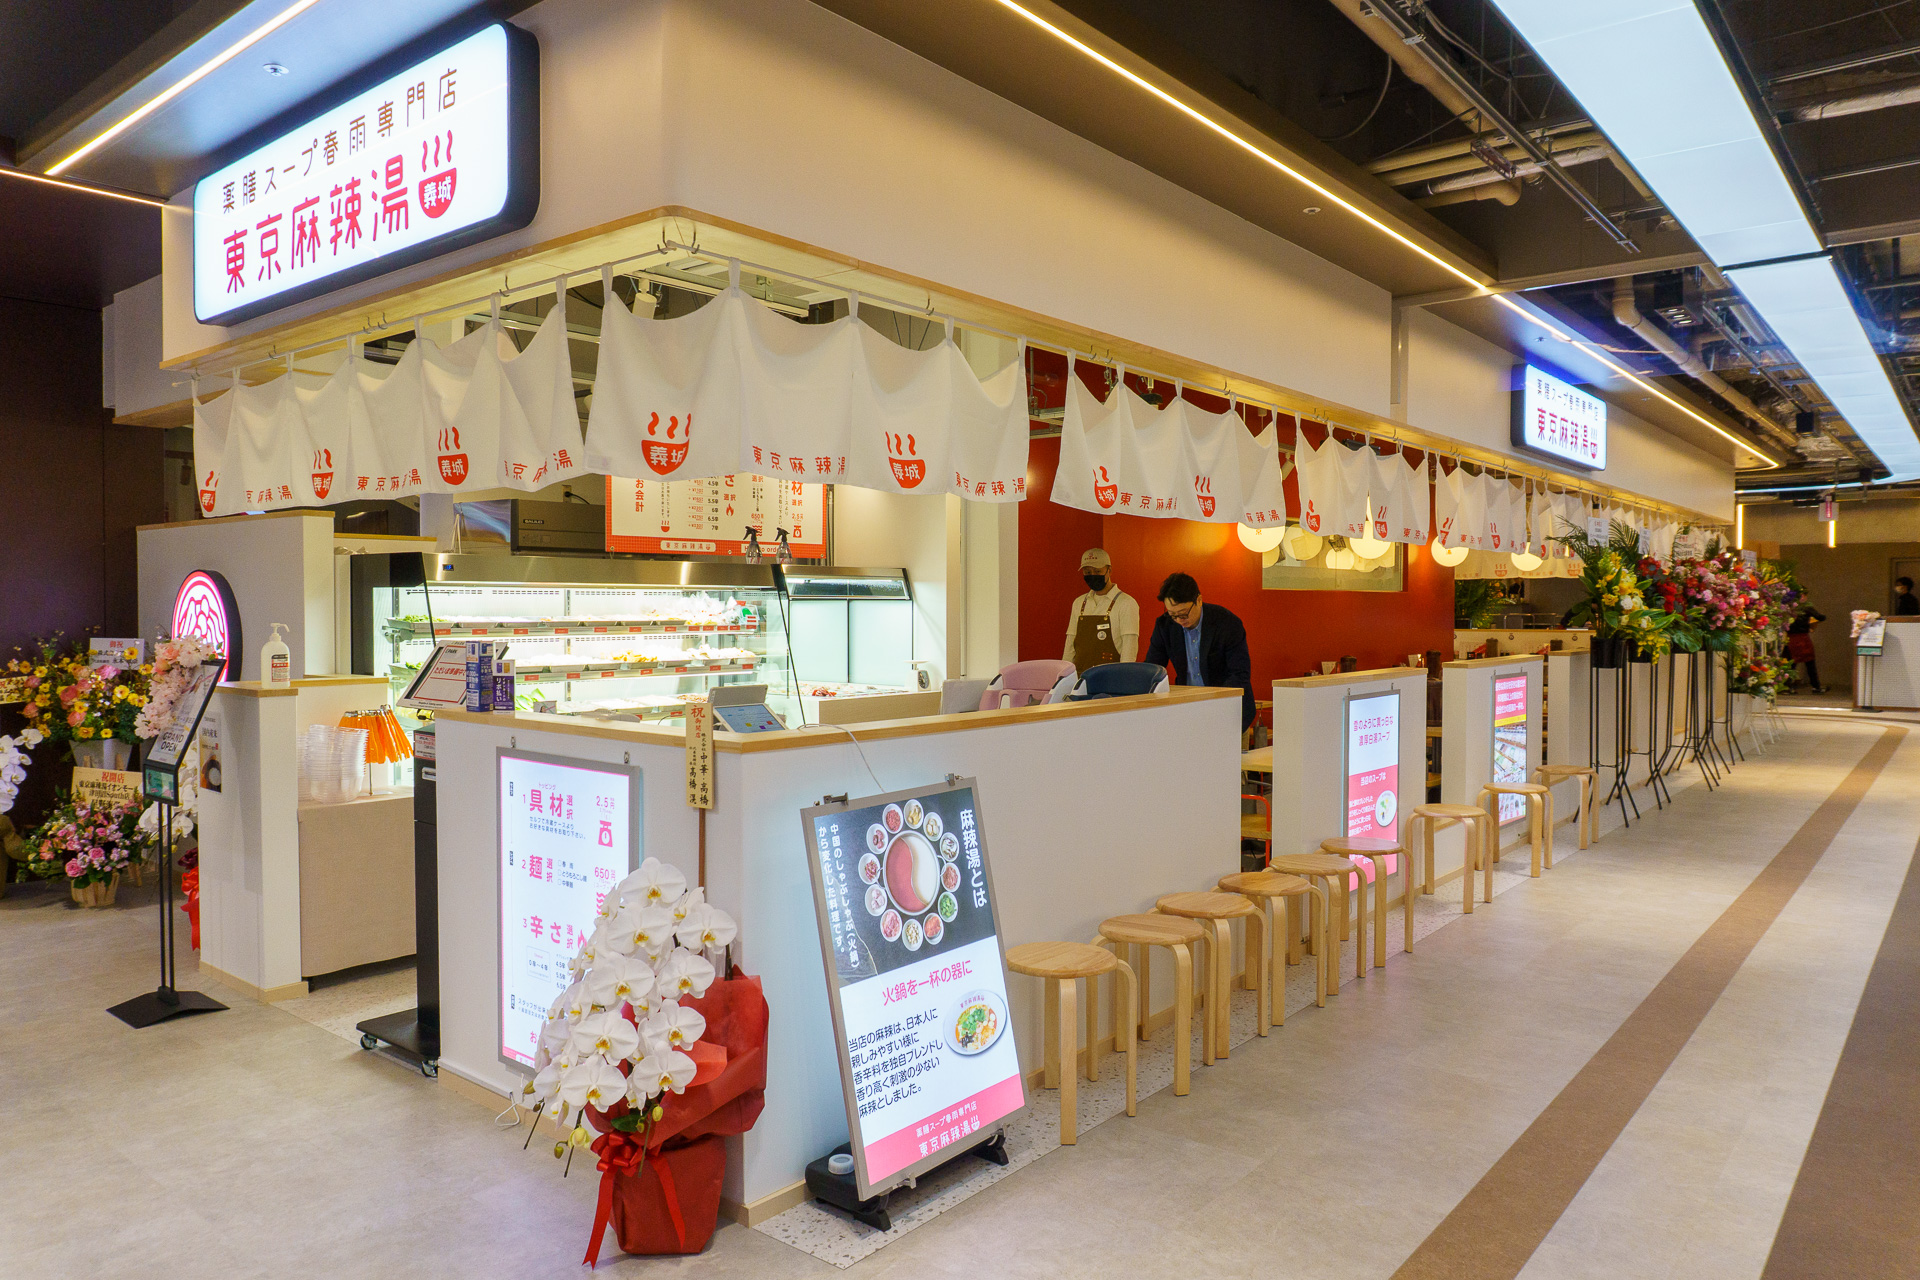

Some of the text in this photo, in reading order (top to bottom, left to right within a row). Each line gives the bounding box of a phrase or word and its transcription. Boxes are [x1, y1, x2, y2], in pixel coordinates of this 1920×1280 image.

[223, 68, 457, 214] 薬膳スープ春雨専門店
[423, 176, 452, 209] 義城
[223, 154, 409, 293] 東京麻辣湯
[440, 459, 464, 478] 義城
[752, 445, 848, 475] 東京麻辣湯
[892, 462, 920, 481] 義城
[635, 478, 644, 512] お会計
[955, 472, 1026, 497] 東京麻辣湯
[160, 740, 178, 752] OPEN
[529, 789, 563, 817] 具材
[529, 854, 542, 879] 麺
[960, 808, 987, 909] 麻辣湯とは
[818, 826, 845, 954] から変化した料理です。
[530, 915, 561, 944] 辛さ
[882, 959, 973, 1006] 火鍋を一杯の器に
[848, 1008, 938, 1053] 当店の麻辣は、日本人に
[851, 1031, 920, 1069] 親しみやすい様に
[854, 1039, 943, 1085] 香辛料を独自ブレンドし
[856, 1056, 940, 1102] 香り高く刺激の少ない
[859, 1085, 923, 1118] 麻辣としました。
[918, 1121, 972, 1158] 東京麻辣湯
